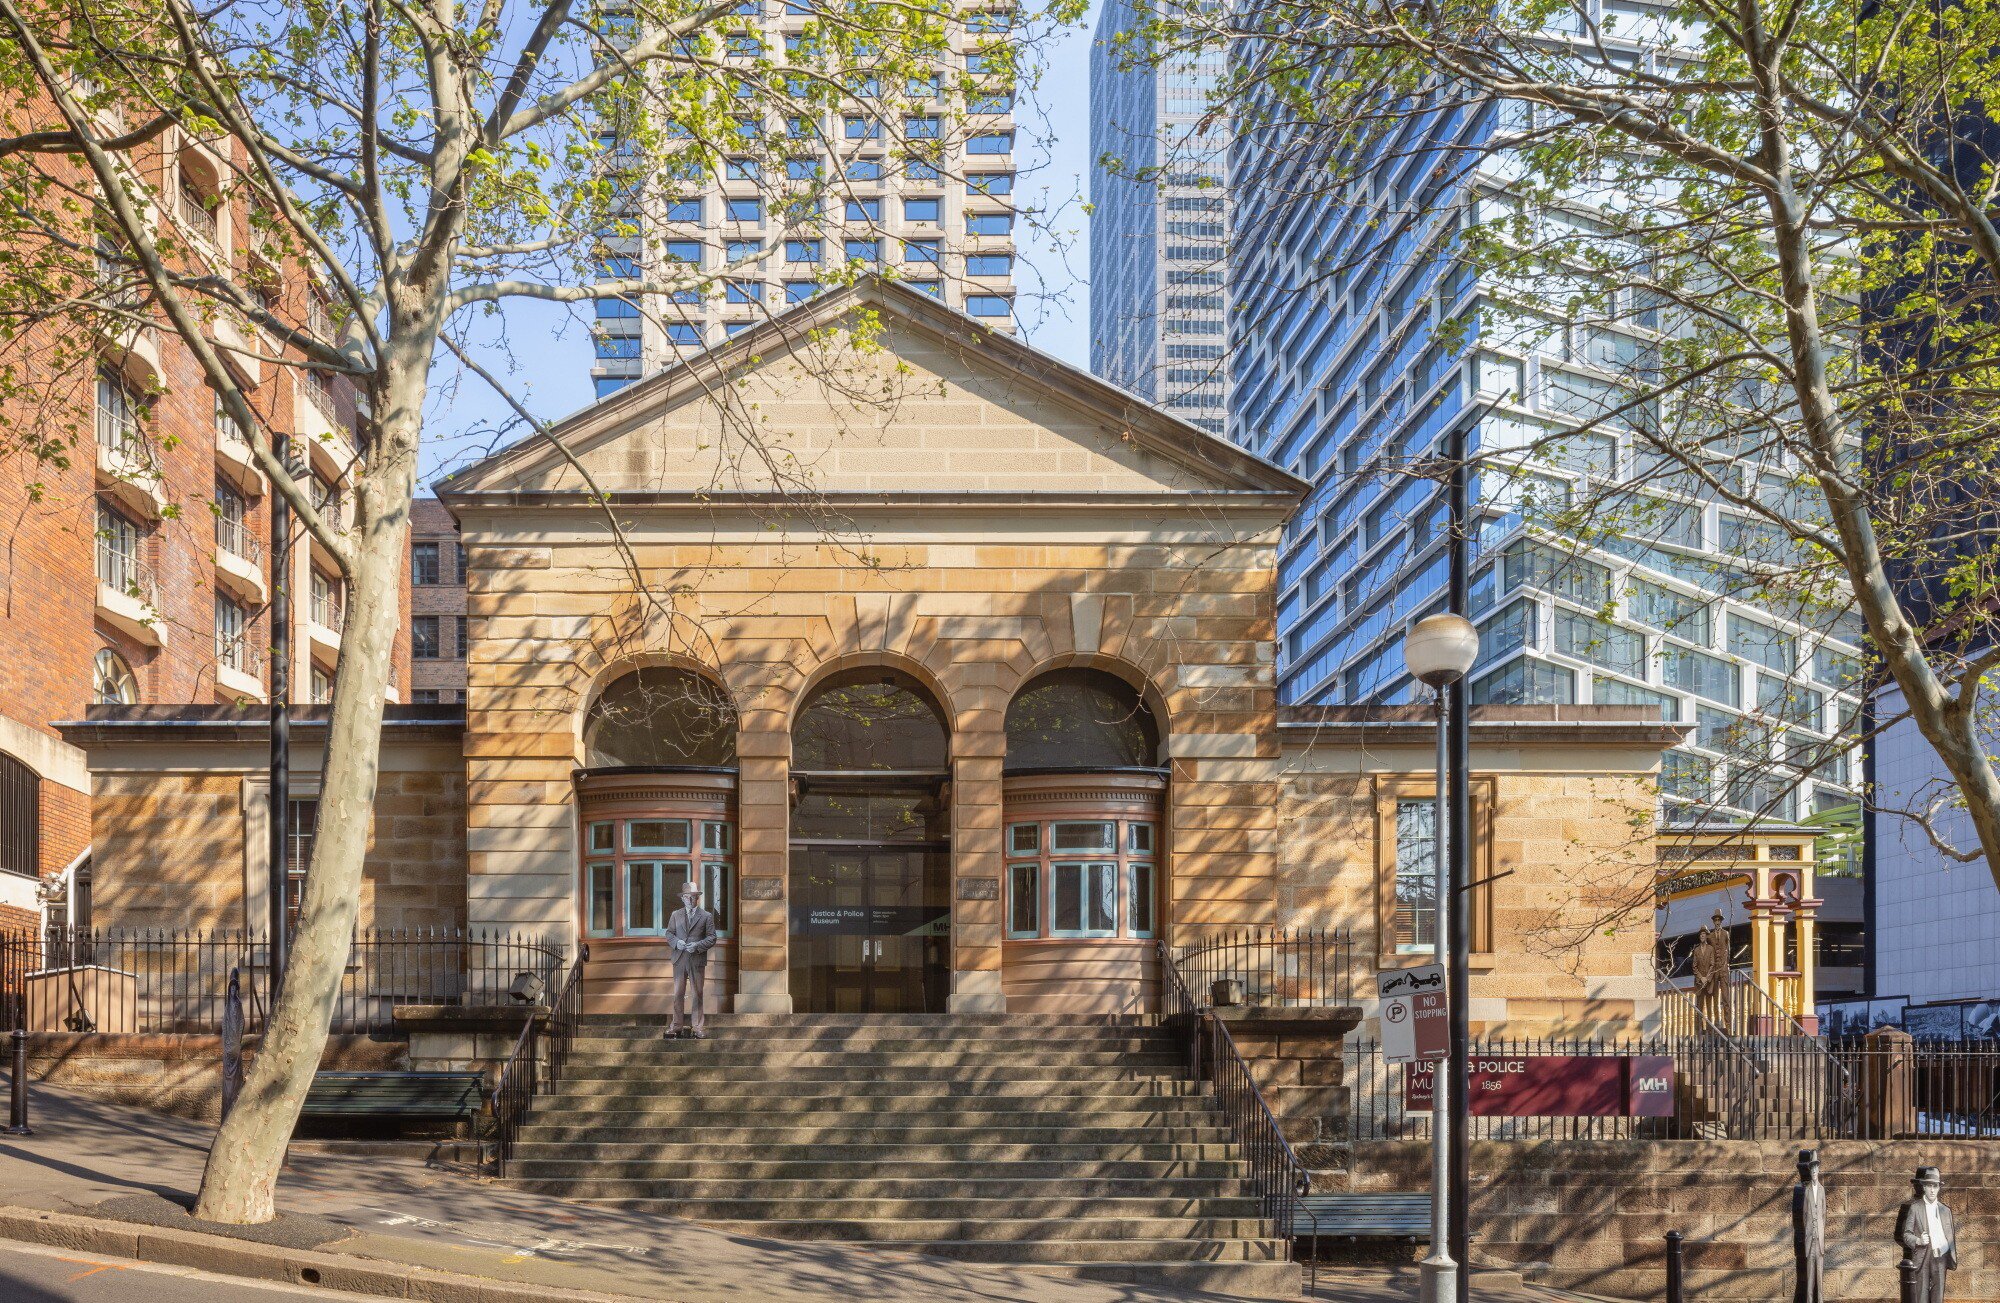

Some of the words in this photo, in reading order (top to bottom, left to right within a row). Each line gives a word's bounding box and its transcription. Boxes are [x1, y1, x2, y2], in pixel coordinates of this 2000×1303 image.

[1422, 996, 1437, 1007] NO
[1414, 1007, 1447, 1019] STOPPING
[1478, 1061, 1525, 1073] POLICE
[1481, 1080, 1502, 1091] 1856
[1639, 1077, 1668, 1091] MH
